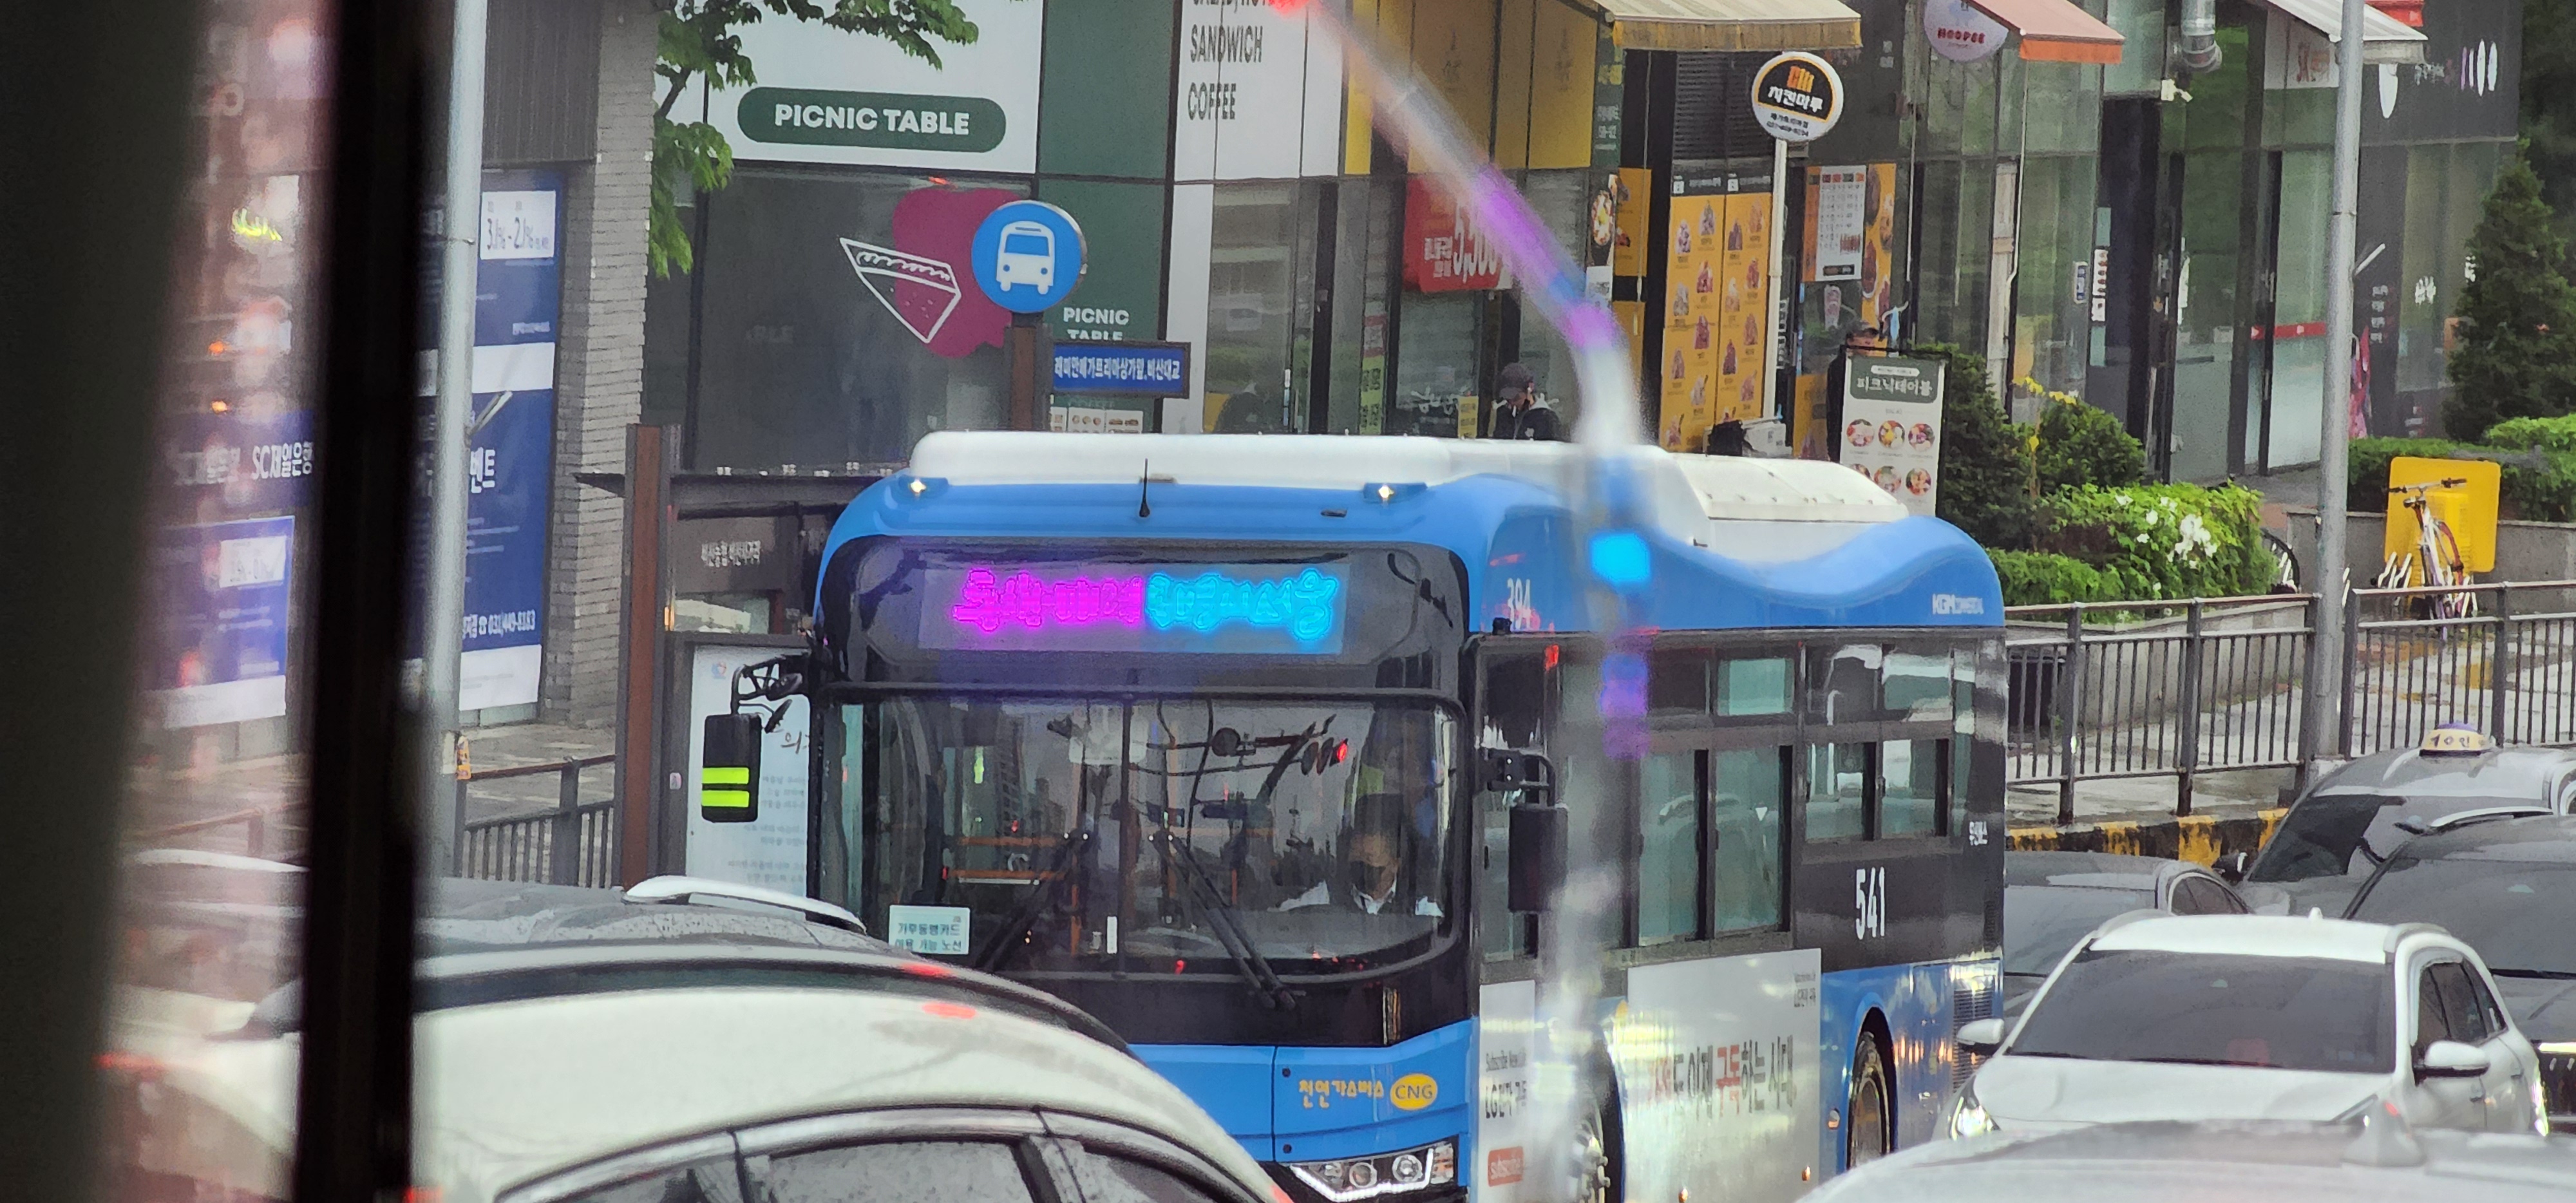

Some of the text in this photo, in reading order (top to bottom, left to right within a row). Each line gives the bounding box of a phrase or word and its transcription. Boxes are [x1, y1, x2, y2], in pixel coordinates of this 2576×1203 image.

[1190, 24, 1263, 63] SANDWICH
[1188, 82, 1236, 120] COFFEE
[1768, 86, 1823, 113] 치킨마루
[775, 104, 969, 135] PICNIC TABLE
[1063, 307, 1130, 325] PICNIC
[1067, 329, 1122, 341] TABLE
[1857, 376, 1933, 397] 피크닉테이블
[469, 446, 496, 493] 벤트
[1507, 578, 1531, 630] 394
[1855, 866, 1885, 940] 541
[942, 939, 961, 952] 노선
[1299, 1079, 1434, 1108] 천연가스버스 CNG
[1716, 1039, 1766, 1118] 구독하는
